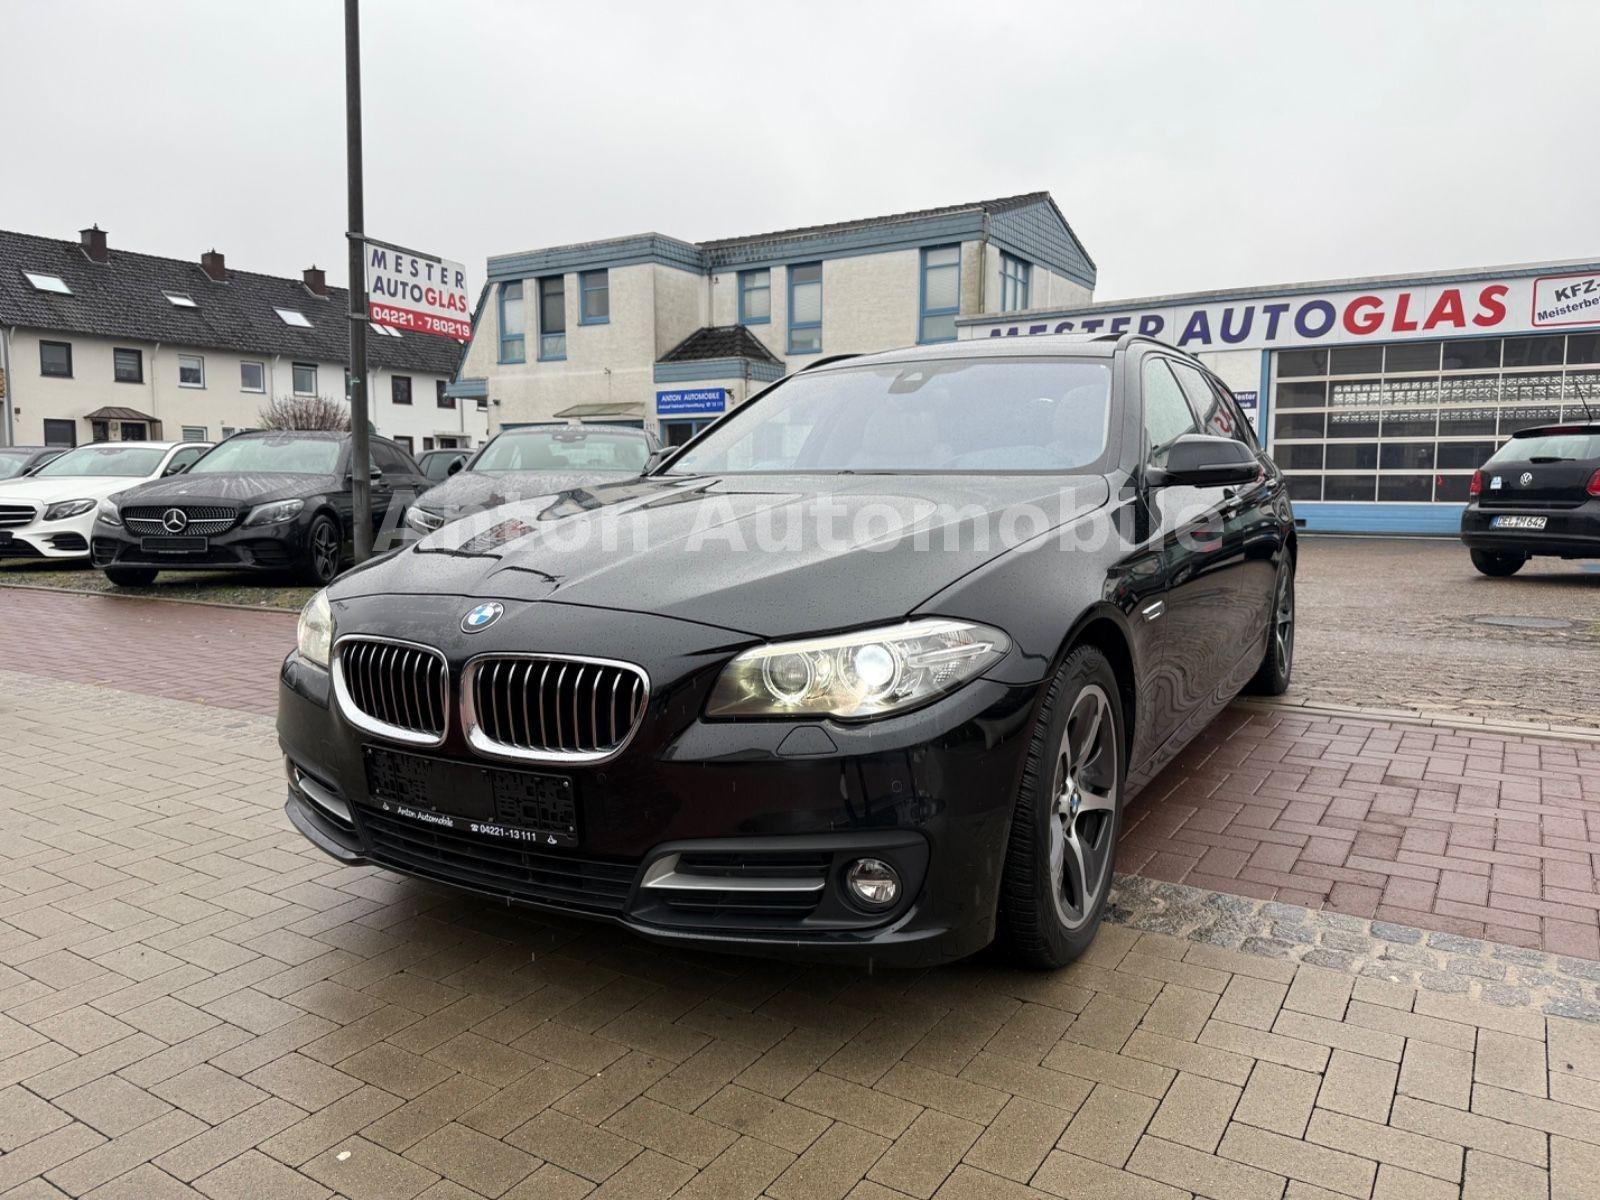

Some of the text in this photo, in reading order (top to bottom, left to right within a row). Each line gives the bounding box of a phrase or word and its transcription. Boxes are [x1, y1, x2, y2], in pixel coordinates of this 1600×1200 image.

[371, 249, 464, 289] MESTER
[373, 276, 467, 313] AUTOGLAS
[1537, 297, 1600, 321] Meisterbe
[373, 307, 414, 326] 04221
[425, 317, 470, 337] 780219
[1177, 285, 1509, 346] AUTOGLAS
[661, 391, 720, 402] ANTON AUTOMOBILE
[397, 806, 454, 827] Anton Automobile
